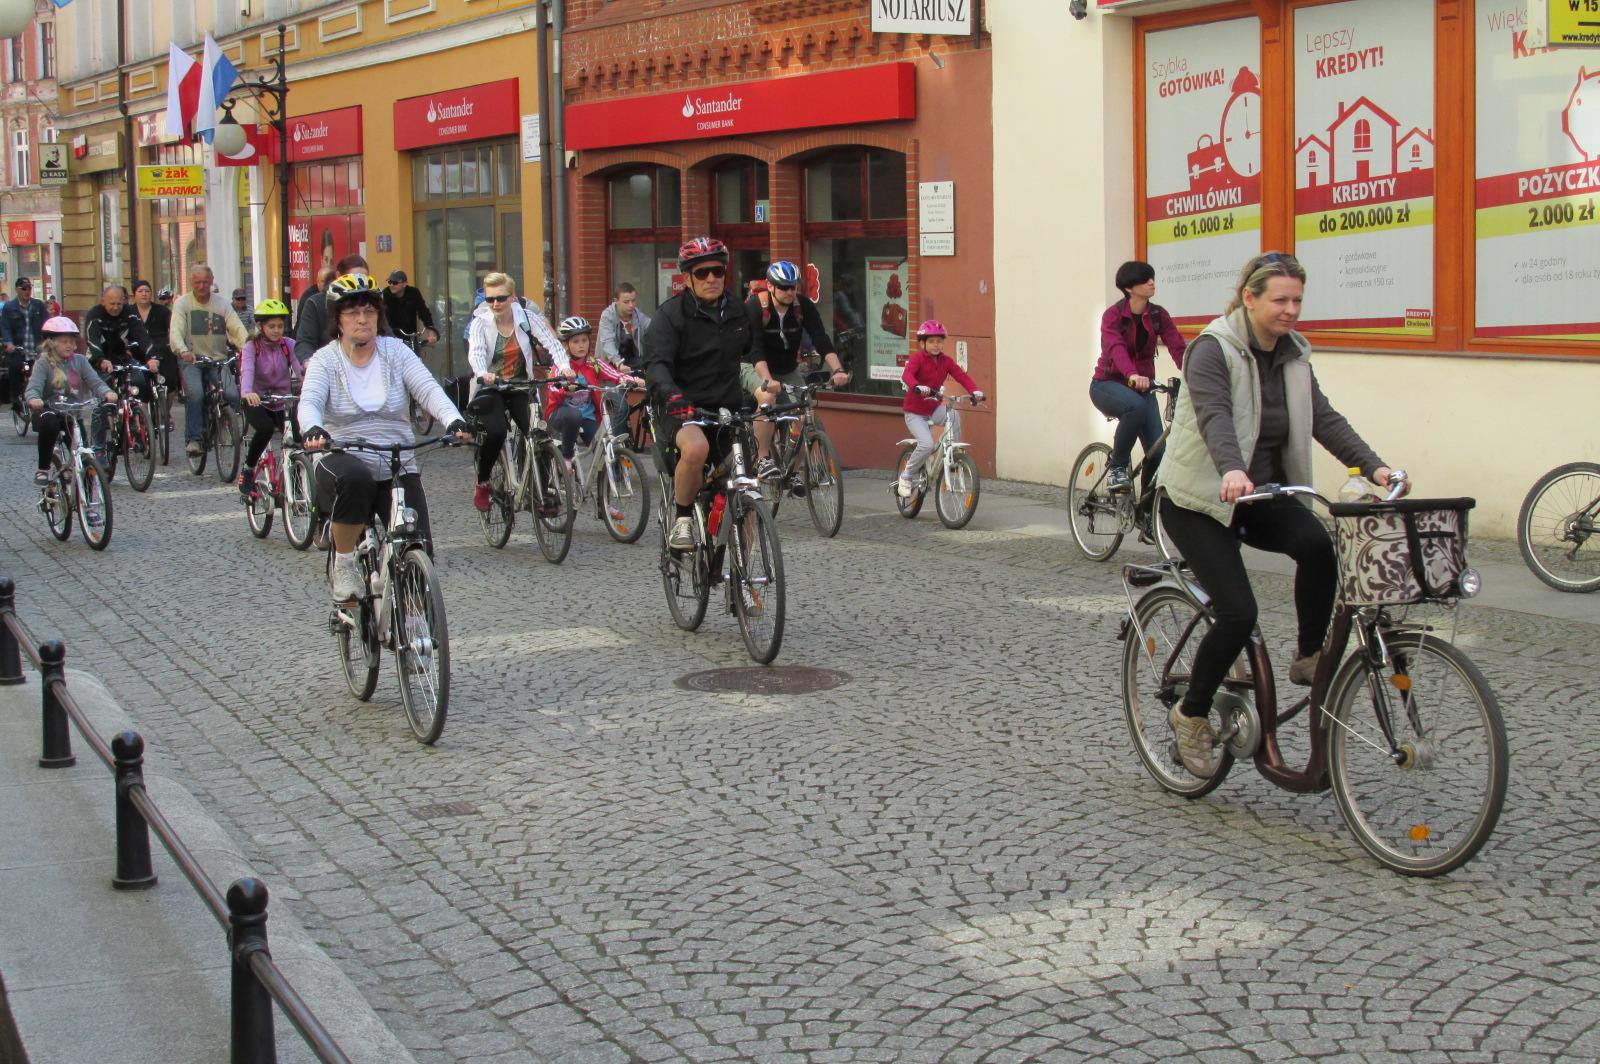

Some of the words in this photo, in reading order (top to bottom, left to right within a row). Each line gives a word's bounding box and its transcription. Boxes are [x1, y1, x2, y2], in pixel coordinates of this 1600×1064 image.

[878, 0, 965, 22] NOTARIUSZ
[1584, 0, 1598, 12] 15
[1306, 27, 1355, 55] Lepszy
[1151, 56, 1188, 80] Szybka
[1315, 46, 1383, 79] KREDYT!
[1158, 68, 1225, 98] GOTÓWKA!
[437, 97, 474, 121] Santander
[695, 92, 742, 115] Santander
[301, 121, 329, 140] Santander
[696, 120, 721, 131] CONSUMER
[721, 119, 735, 128] BANK
[165, 167, 189, 179] żak
[1518, 165, 1600, 198] POŻYCZK
[157, 186, 202, 196] DARMO!
[1166, 186, 1242, 216] CHWILÓWKI
[1332, 177, 1397, 204] KREDYTY
[1173, 221, 1188, 238] do
[1190, 215, 1220, 236] 1.000
[1223, 212, 1234, 231] zł
[1319, 214, 1337, 233] do
[1340, 206, 1393, 231] 200.000
[1396, 203, 1411, 224] zł
[1528, 202, 1574, 228] 2.000
[1578, 198, 1596, 221] zł
[288, 224, 309, 248] Wejdź
